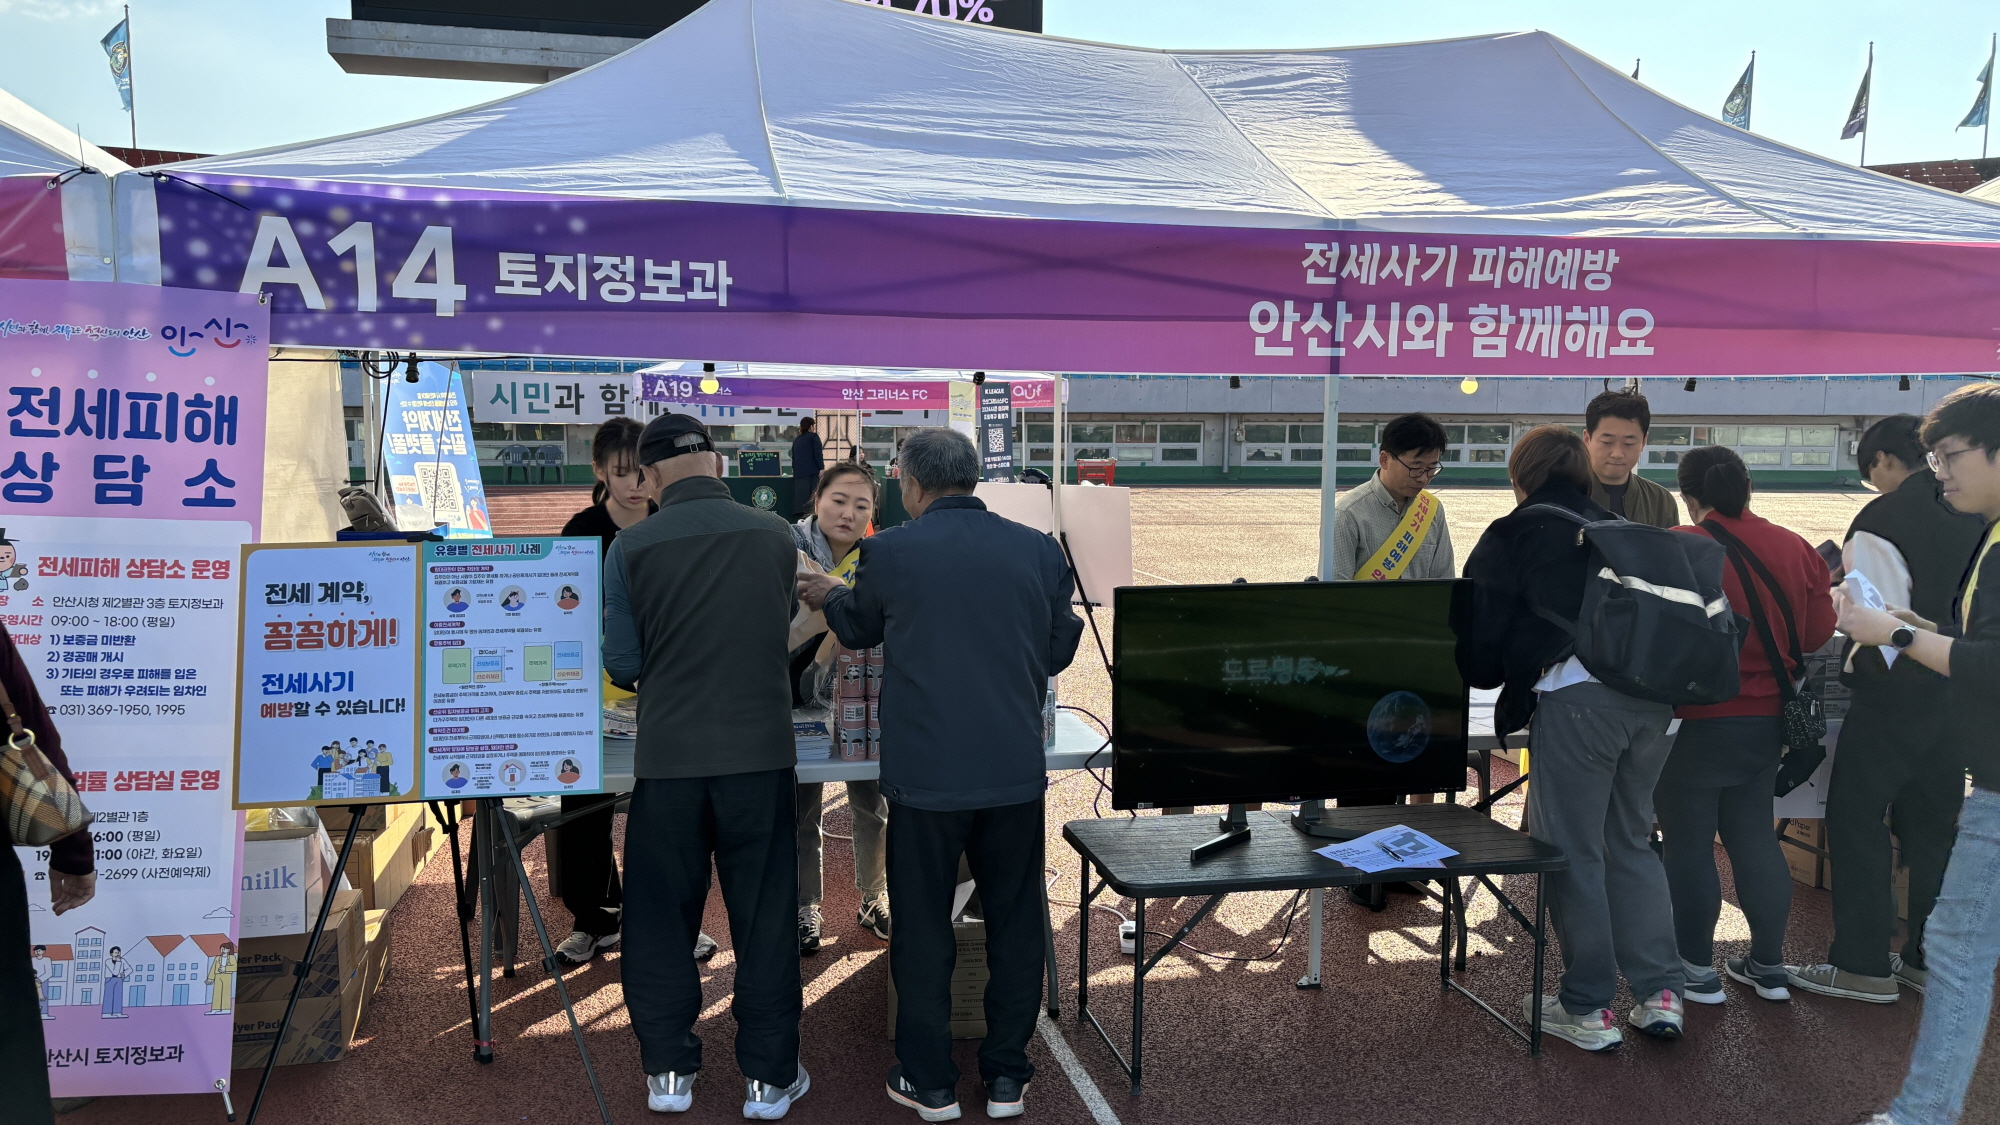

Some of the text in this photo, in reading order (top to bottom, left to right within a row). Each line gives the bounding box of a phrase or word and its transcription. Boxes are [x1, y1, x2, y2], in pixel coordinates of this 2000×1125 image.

[915, 0, 994, 23] 0%
[239, 216, 466, 317] A14
[1302, 242, 1619, 292] 전세사기 피해예방
[495, 252, 733, 307] 토지정보과
[122, 327, 153, 340] 안산
[1249, 300, 1655, 359] 안산시와 함께해요
[489, 382, 585, 416] 시민과
[599, 383, 660, 416] 함
[653, 380, 693, 399] A19
[842, 388, 928, 401] 안산 그리너스 FC
[7, 386, 239, 446] 전세피해
[1410, 493, 1431, 533] 전세사기
[435, 544, 469, 556] 유형별
[471, 543, 516, 556] 전세사기
[519, 543, 542, 555] 사례
[1382, 530, 1414, 571] 피해예방
[38, 557, 231, 580] 전세피해 상담소 운영
[265, 581, 370, 604] 전세 계약,
[32, 596, 45, 607] 소
[53, 596, 99, 609] 안산시청
[102, 597, 145, 610] 제2별관
[147, 598, 166, 610] 3층
[168, 598, 224, 610] 토지정보과
[51, 615, 90, 628] 09:00
[104, 616, 139, 628] 18:00
[142, 616, 175, 628] (평일)
[50, 634, 60, 646] 1)
[63, 634, 98, 647] 보증금
[101, 635, 136, 647] 미반환
[264, 617, 397, 651] 꼼꼼하게!
[47, 651, 124, 664] 2) 경공매 개시
[46, 668, 197, 680] 3) 기타의 경우로 피해를 입은
[1221, 656, 1350, 685] 도로명주
[60, 685, 207, 697] 또는 피해가 우려되는 임차인
[262, 671, 354, 696] 전세사기
[59, 704, 186, 717] 031) 369-1950, 1995
[260, 698, 405, 718] 예방할 수 있습니다!
[114, 770, 174, 792] 상담실
[180, 769, 220, 791] 운영
[133, 811, 149, 823] 1층
[127, 830, 161, 843] (평일)
[126, 848, 158, 861] (야간,
[162, 846, 202, 860] 화요일)
[141, 866, 211, 880] (사전예약제)
[254, 953, 282, 963] Pack
[94, 1044, 184, 1065] 토지정보과
